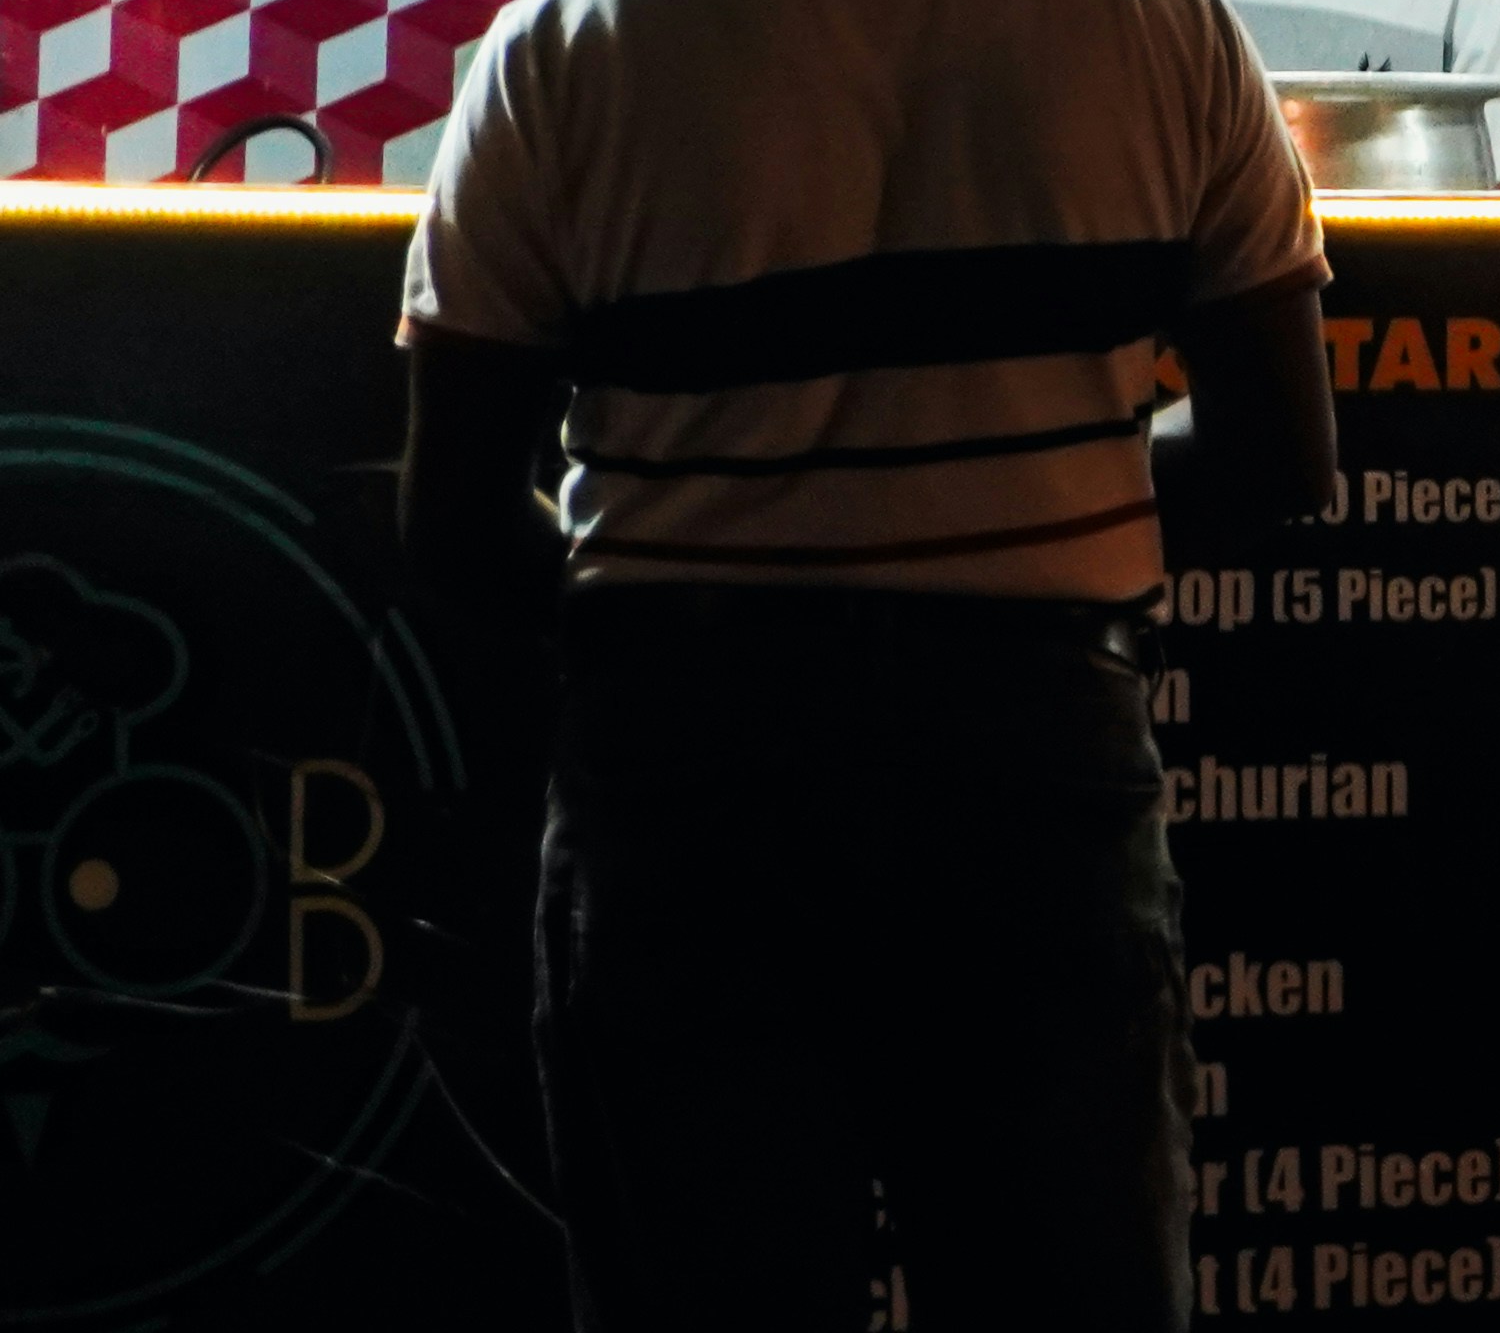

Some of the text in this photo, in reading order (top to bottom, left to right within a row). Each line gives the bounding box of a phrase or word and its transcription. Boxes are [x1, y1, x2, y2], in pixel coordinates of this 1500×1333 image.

[1272, 566, 1325, 623] (5
[1336, 564, 1497, 622] Piece)
[1243, 1143, 1306, 1216] (4
[1235, 1244, 1297, 1315] (4
